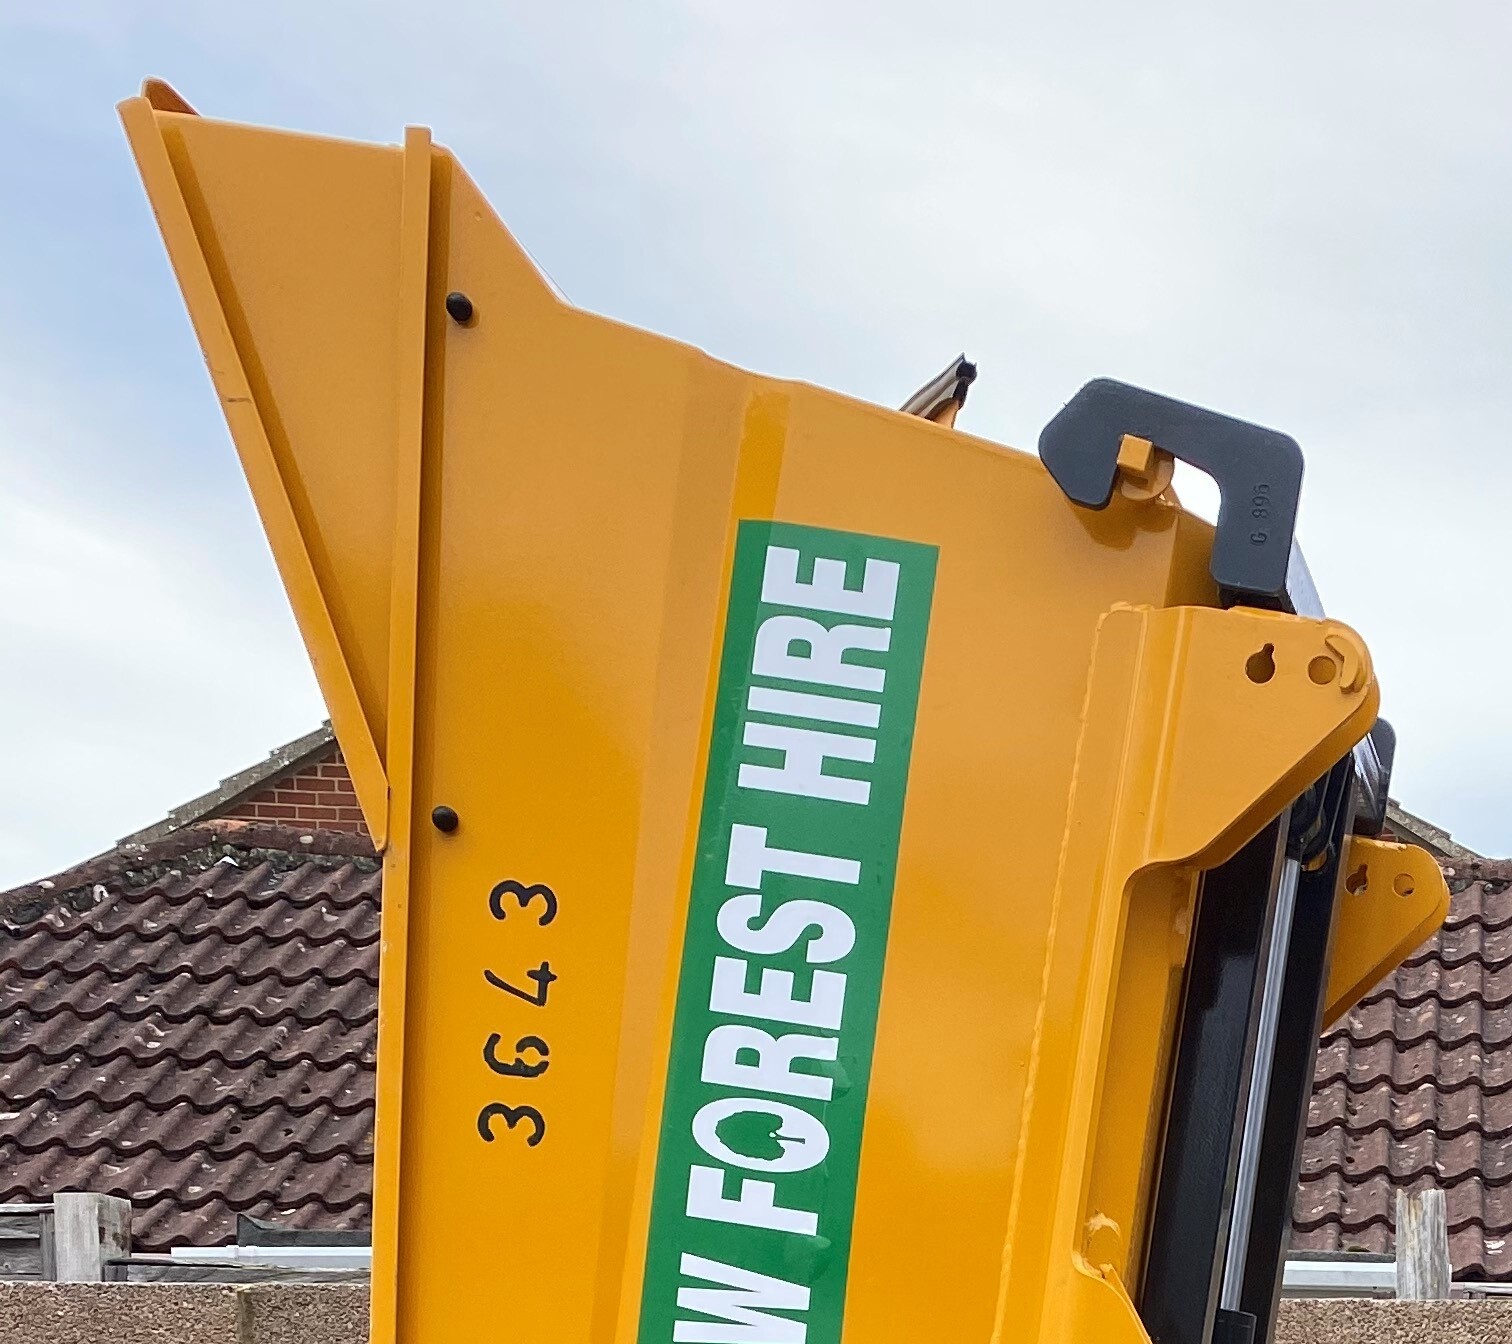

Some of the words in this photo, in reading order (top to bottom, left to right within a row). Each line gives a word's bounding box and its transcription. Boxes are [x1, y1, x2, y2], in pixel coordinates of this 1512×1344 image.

[738, 545, 901, 806] HIRE
[477, 879, 558, 1147] 3643
[686, 823, 862, 1237] FOREST
